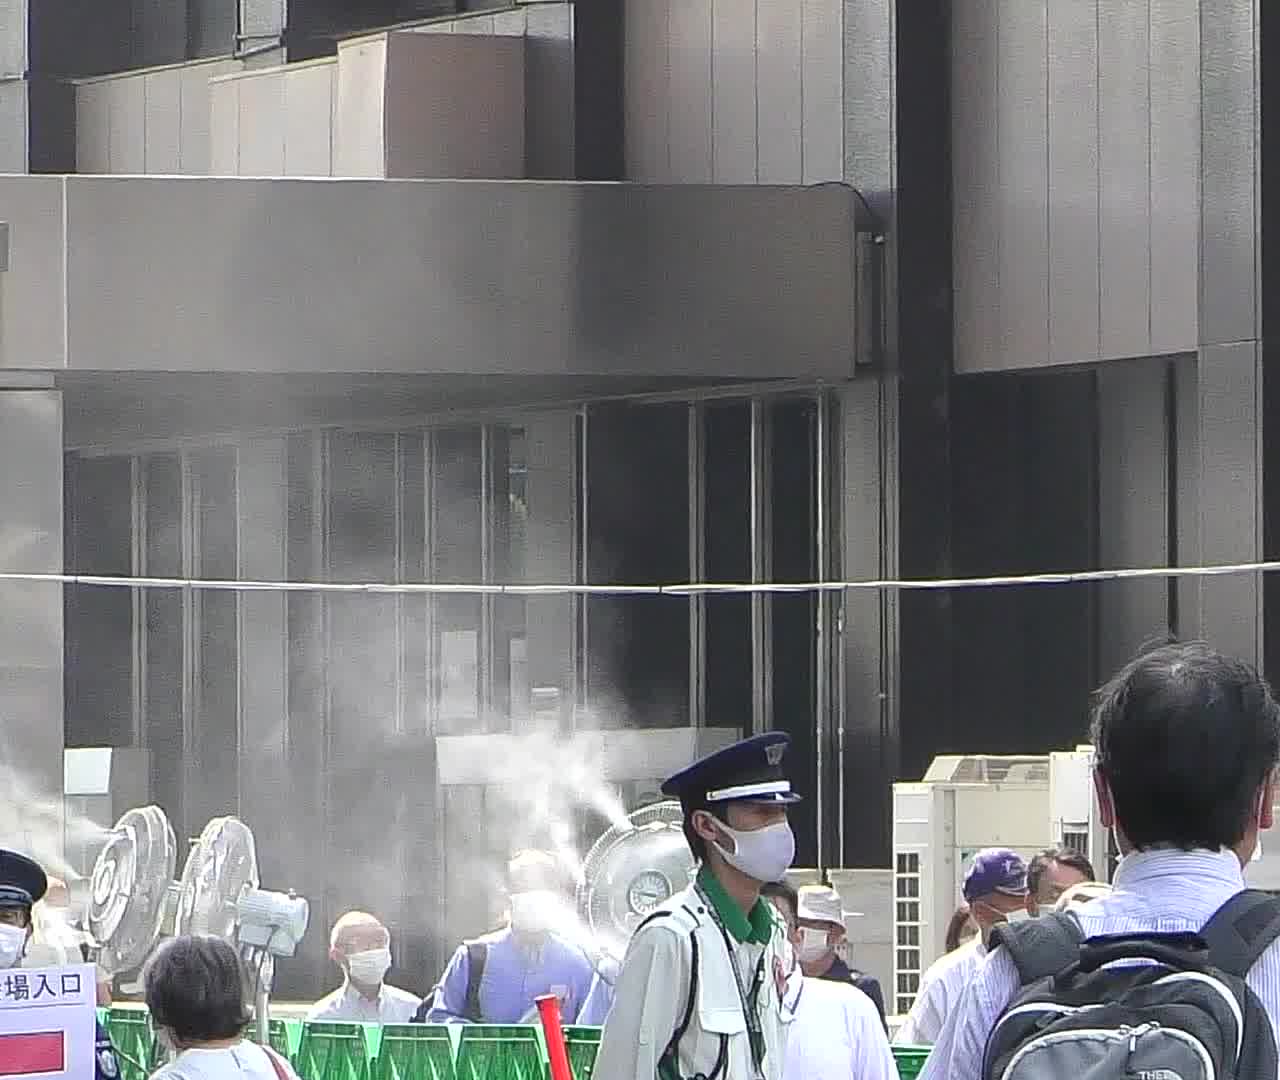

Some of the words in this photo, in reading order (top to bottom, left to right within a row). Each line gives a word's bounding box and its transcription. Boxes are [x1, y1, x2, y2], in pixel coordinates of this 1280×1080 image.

[0, 973, 82, 1001] 場入口
[1139, 1071, 1168, 1080] THE
